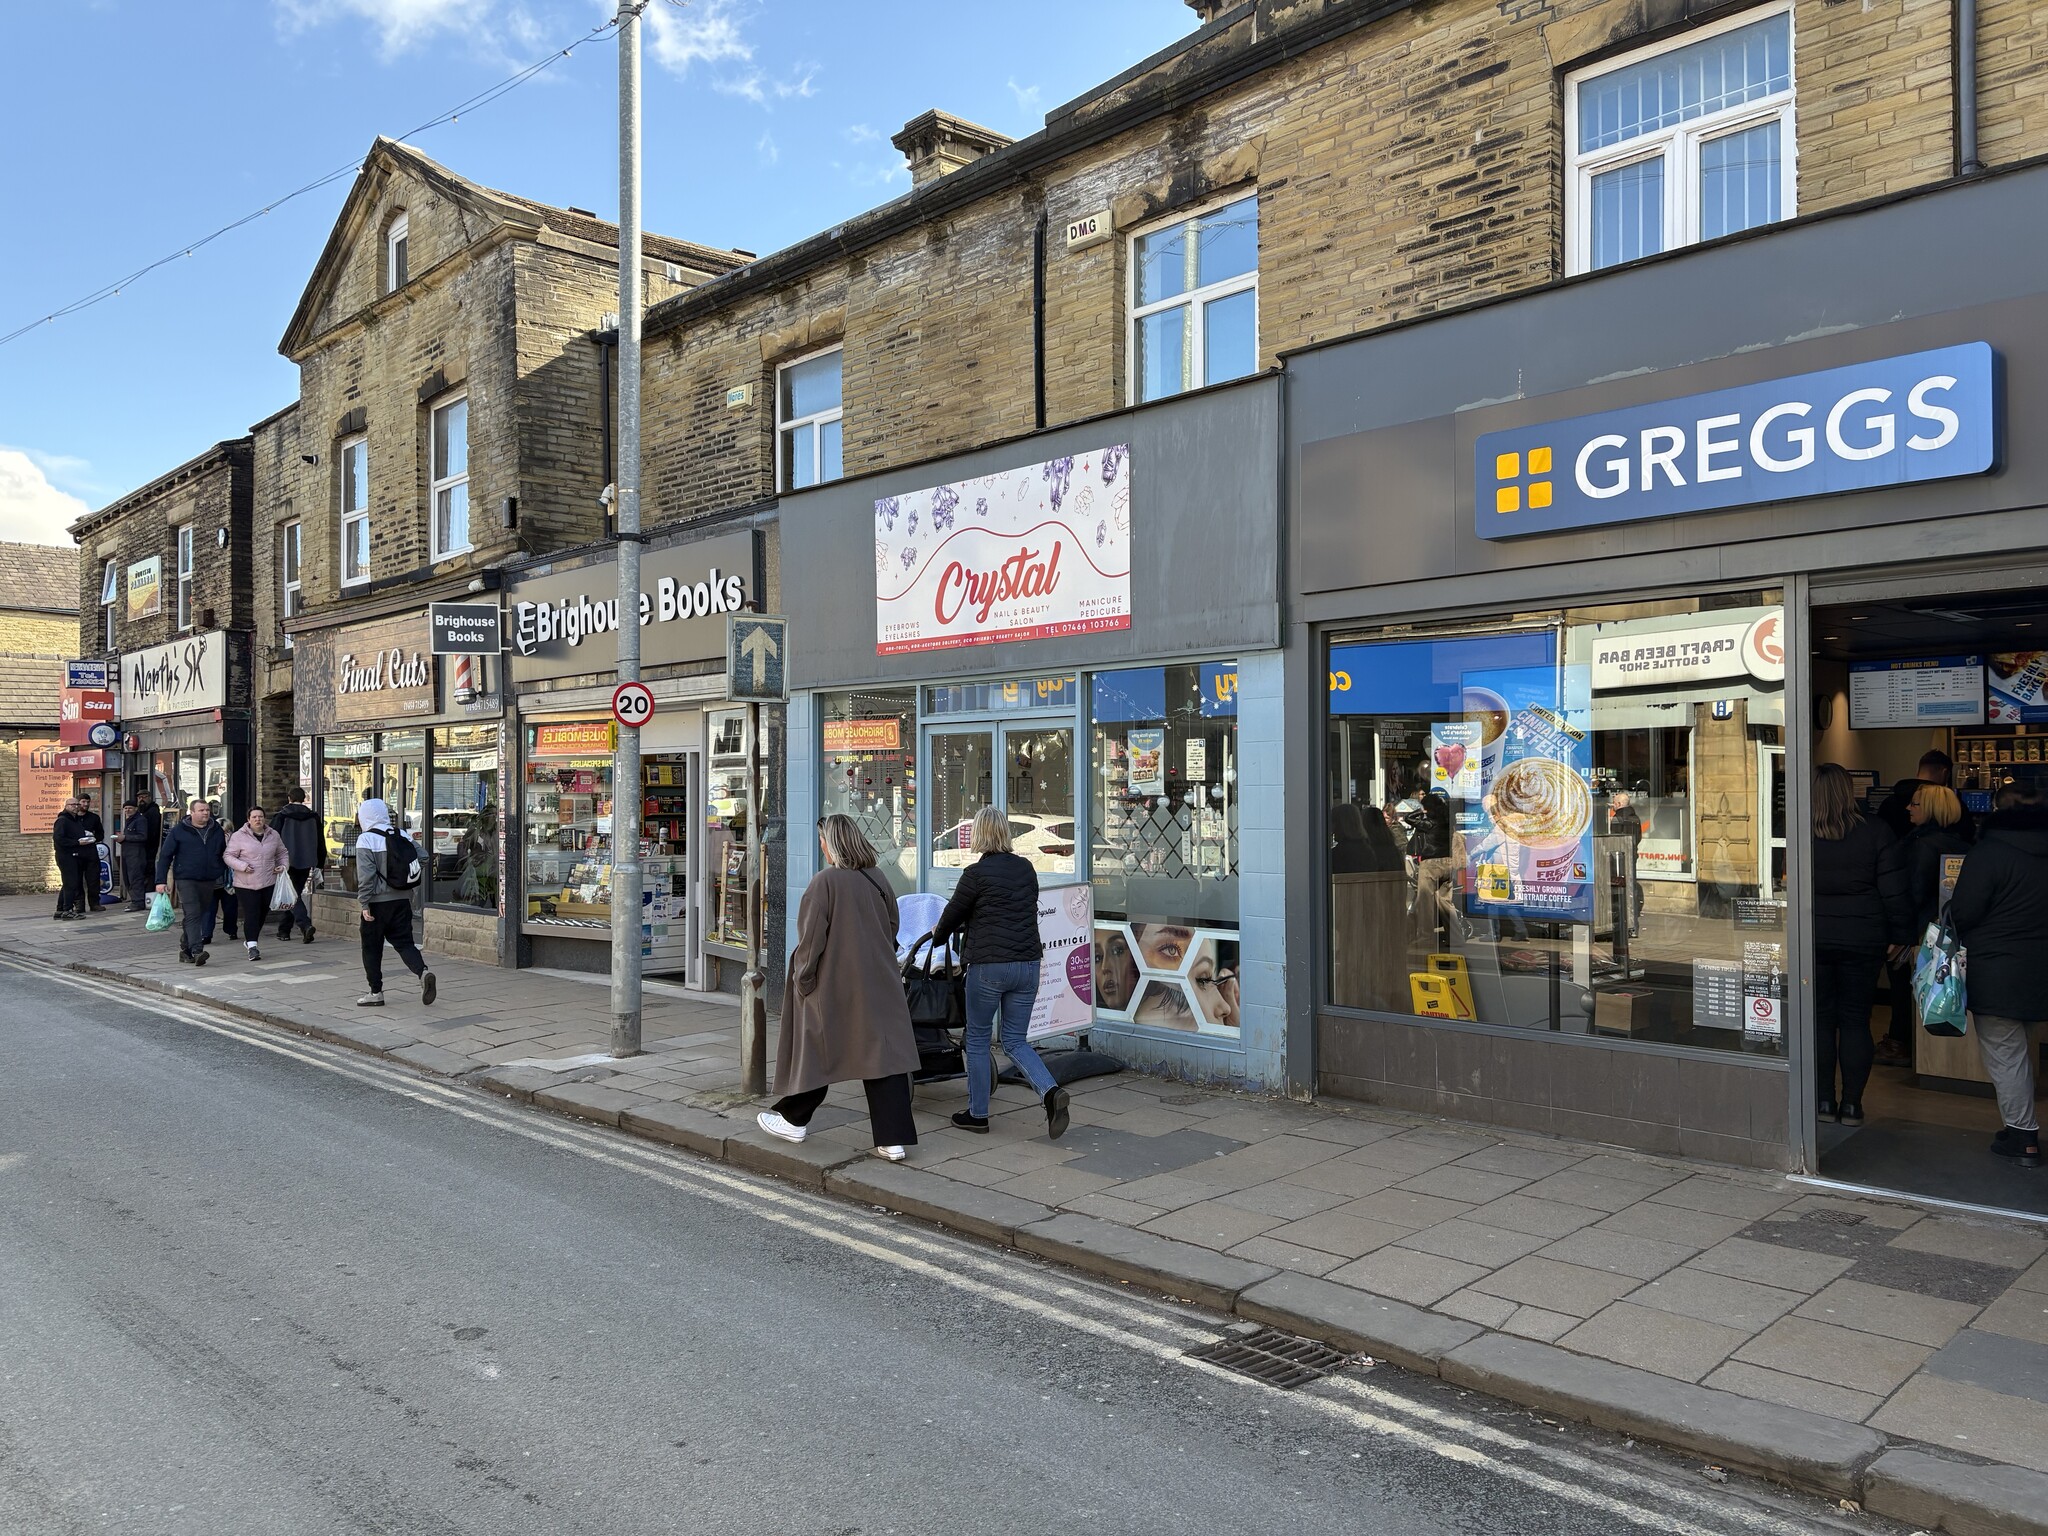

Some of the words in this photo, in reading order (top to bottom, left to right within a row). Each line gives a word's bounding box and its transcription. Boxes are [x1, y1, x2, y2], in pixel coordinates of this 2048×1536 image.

[1575, 375, 1960, 499] GREGGS
[935, 541, 1061, 625] Crystal
[537, 593, 651, 646] Brighoue
[658, 568, 743, 622] Books
[1079, 596, 1122, 607] MANICURE
[994, 610, 1010, 618] NAIL
[1013, 608, 1018, 616] &
[1021, 605, 1049, 615] BEAUTY
[1080, 606, 1122, 617] PEDICURE
[436, 615, 495, 629] Brighouse
[885, 622, 920, 632] EYEBROWS
[1009, 618, 1034, 626] SALON
[448, 631, 484, 642] Books
[885, 630, 921, 641] EYELASHES
[339, 650, 384, 694] Final
[388, 648, 426, 689] Cuts
[84, 701, 113, 710] Sun
[619, 696, 648, 714] 20
[1529, 703, 1556, 723] LIMITED
[1517, 710, 1578, 752] CINNAMON
[1542, 886, 1567, 894] GROUND
[1548, 894, 1572, 903] COFFEE
[1038, 907, 1057, 918] rystal
[1048, 935, 1087, 948] SERVICES
